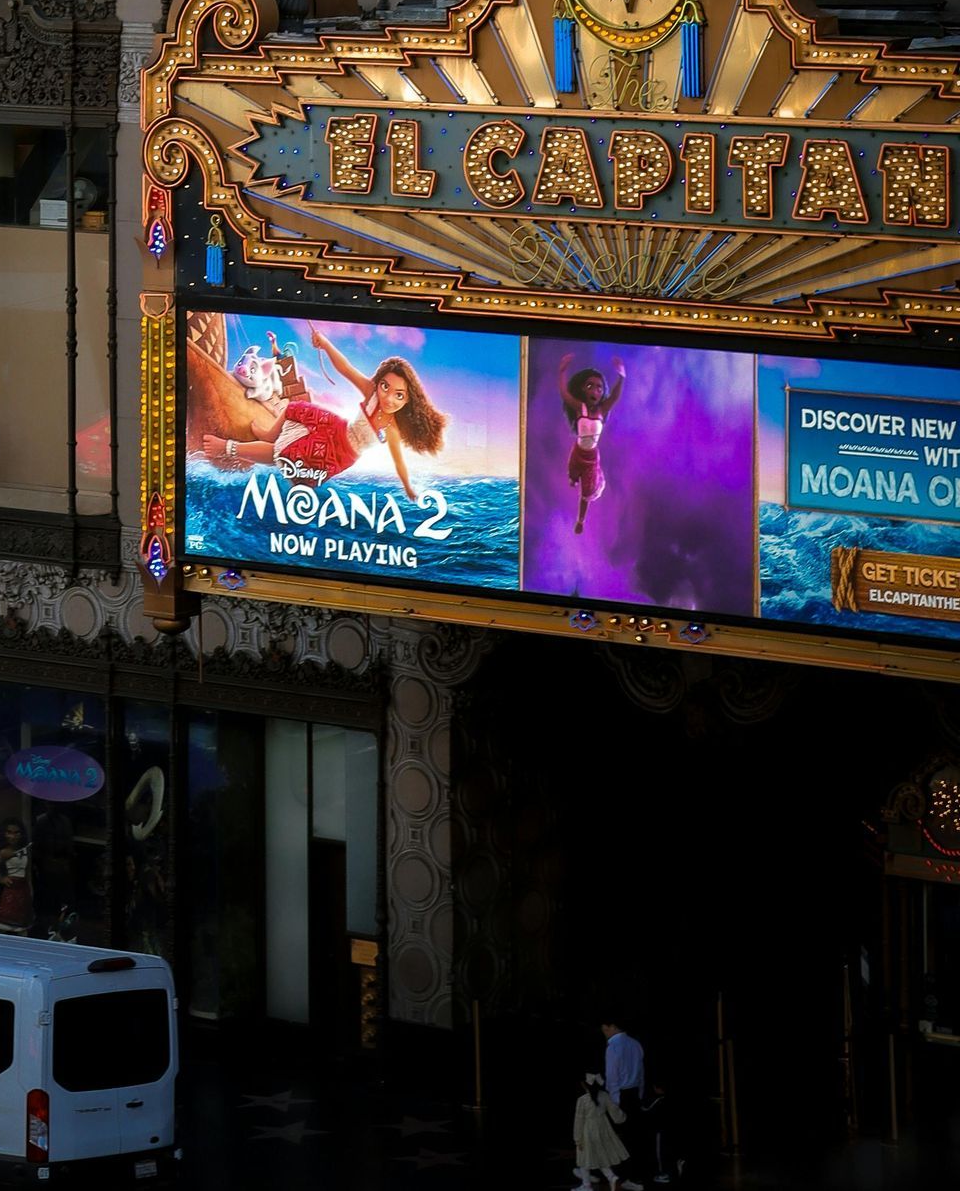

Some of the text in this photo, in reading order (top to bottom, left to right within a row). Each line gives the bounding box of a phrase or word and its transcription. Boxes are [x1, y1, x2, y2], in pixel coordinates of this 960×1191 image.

[589, 52, 671, 112] The
[325, 113, 950, 230] EL CAPITAN
[509, 222, 741, 297] Theatre
[801, 408, 957, 441] DISCOVER NEW
[277, 457, 328, 482] Disney
[924, 446, 960, 467] WIT
[800, 463, 920, 506] MOANA
[236, 472, 453, 540] MOANA 2
[188, 541, 203, 550] PG
[270, 532, 418, 568] NOW PLAYING
[862, 562, 897, 585] GET
[869, 589, 960, 612] ELCAPITANTHE
[84, 767, 97, 788] 2
